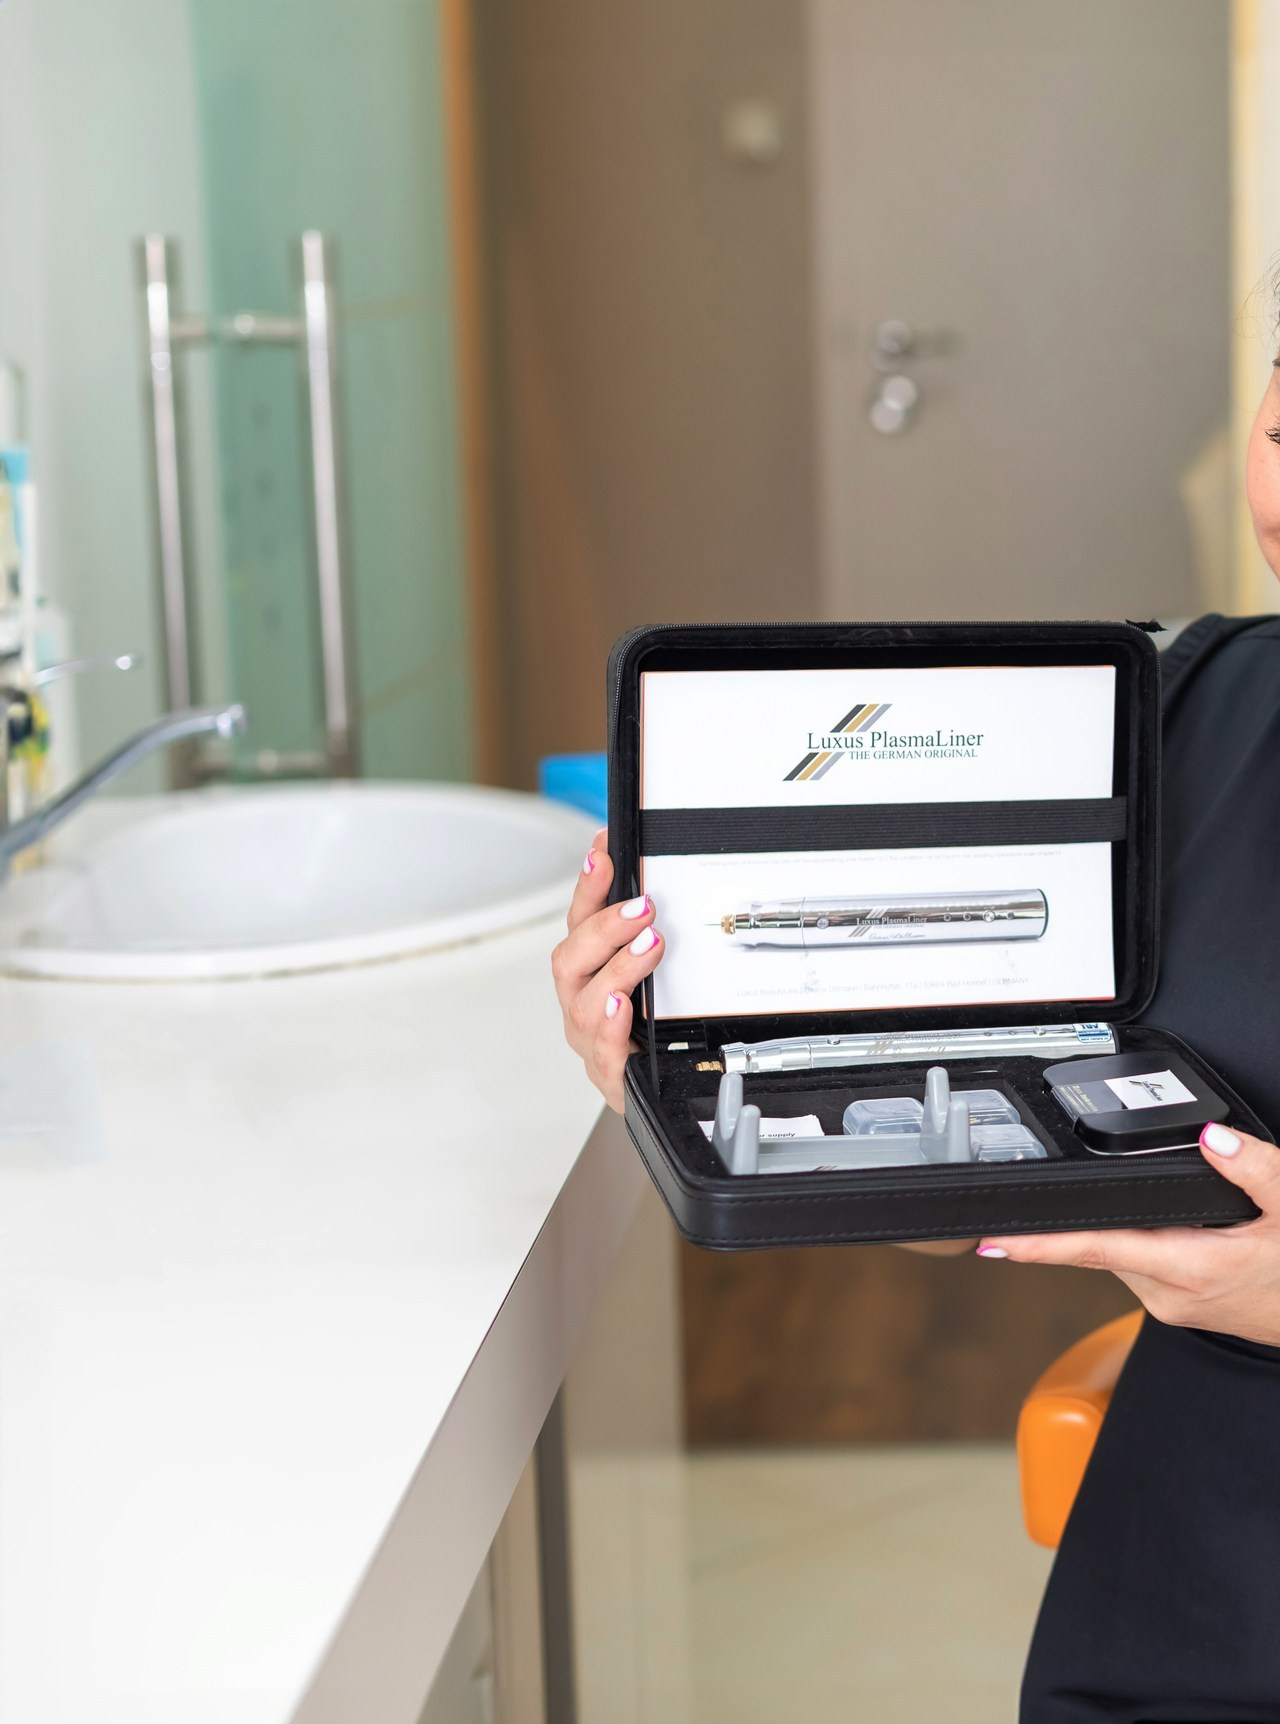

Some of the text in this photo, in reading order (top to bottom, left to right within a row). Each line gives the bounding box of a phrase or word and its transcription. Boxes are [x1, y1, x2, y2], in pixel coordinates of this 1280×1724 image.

[807, 730, 984, 749] Luxus PlasmaLiner
[848, 749, 978, 760] THE GERMAN ORIGINAL
[856, 915, 928, 926] Luxus PlasmaLiner
